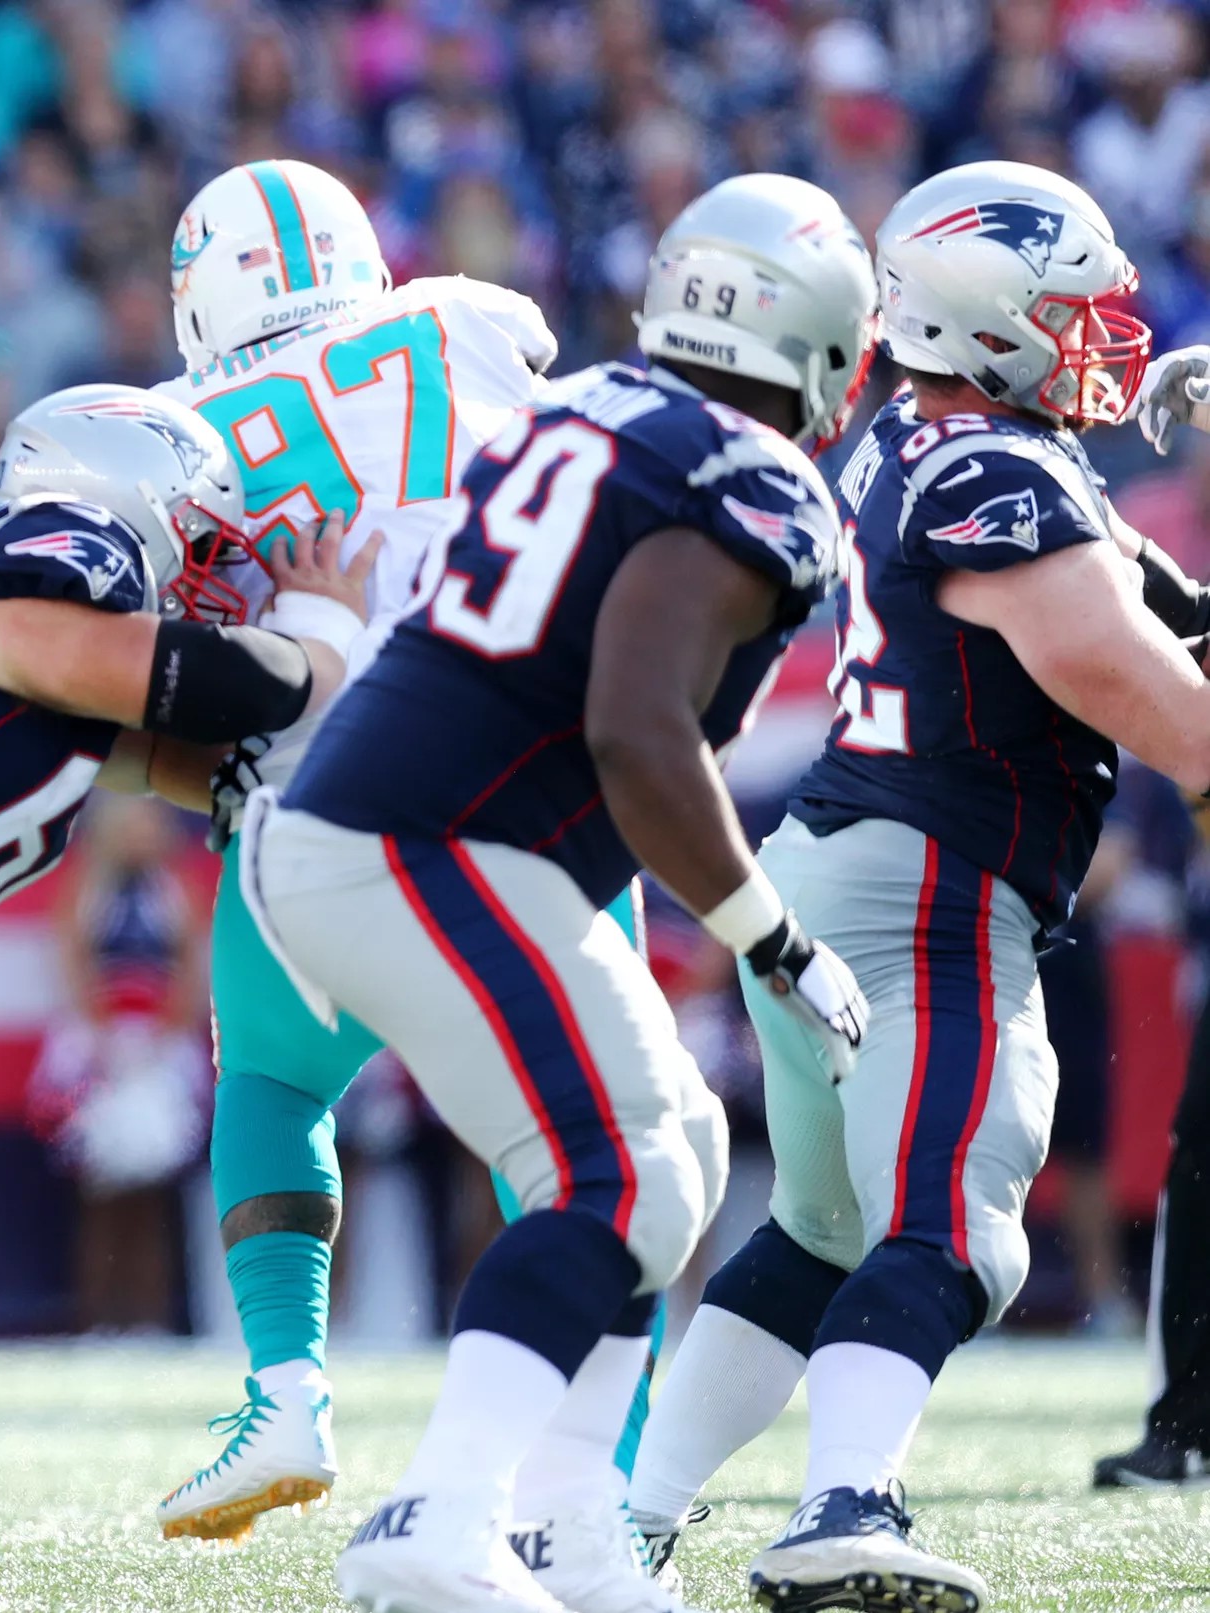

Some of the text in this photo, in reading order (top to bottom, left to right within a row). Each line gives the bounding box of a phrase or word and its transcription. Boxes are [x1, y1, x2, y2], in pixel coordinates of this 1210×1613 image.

[261, 298, 358, 329] Dolphin
[683, 275, 737, 318] 69
[191, 305, 456, 570] 97
[826, 516, 916, 757] 2
[504, 1519, 554, 1572] KE
